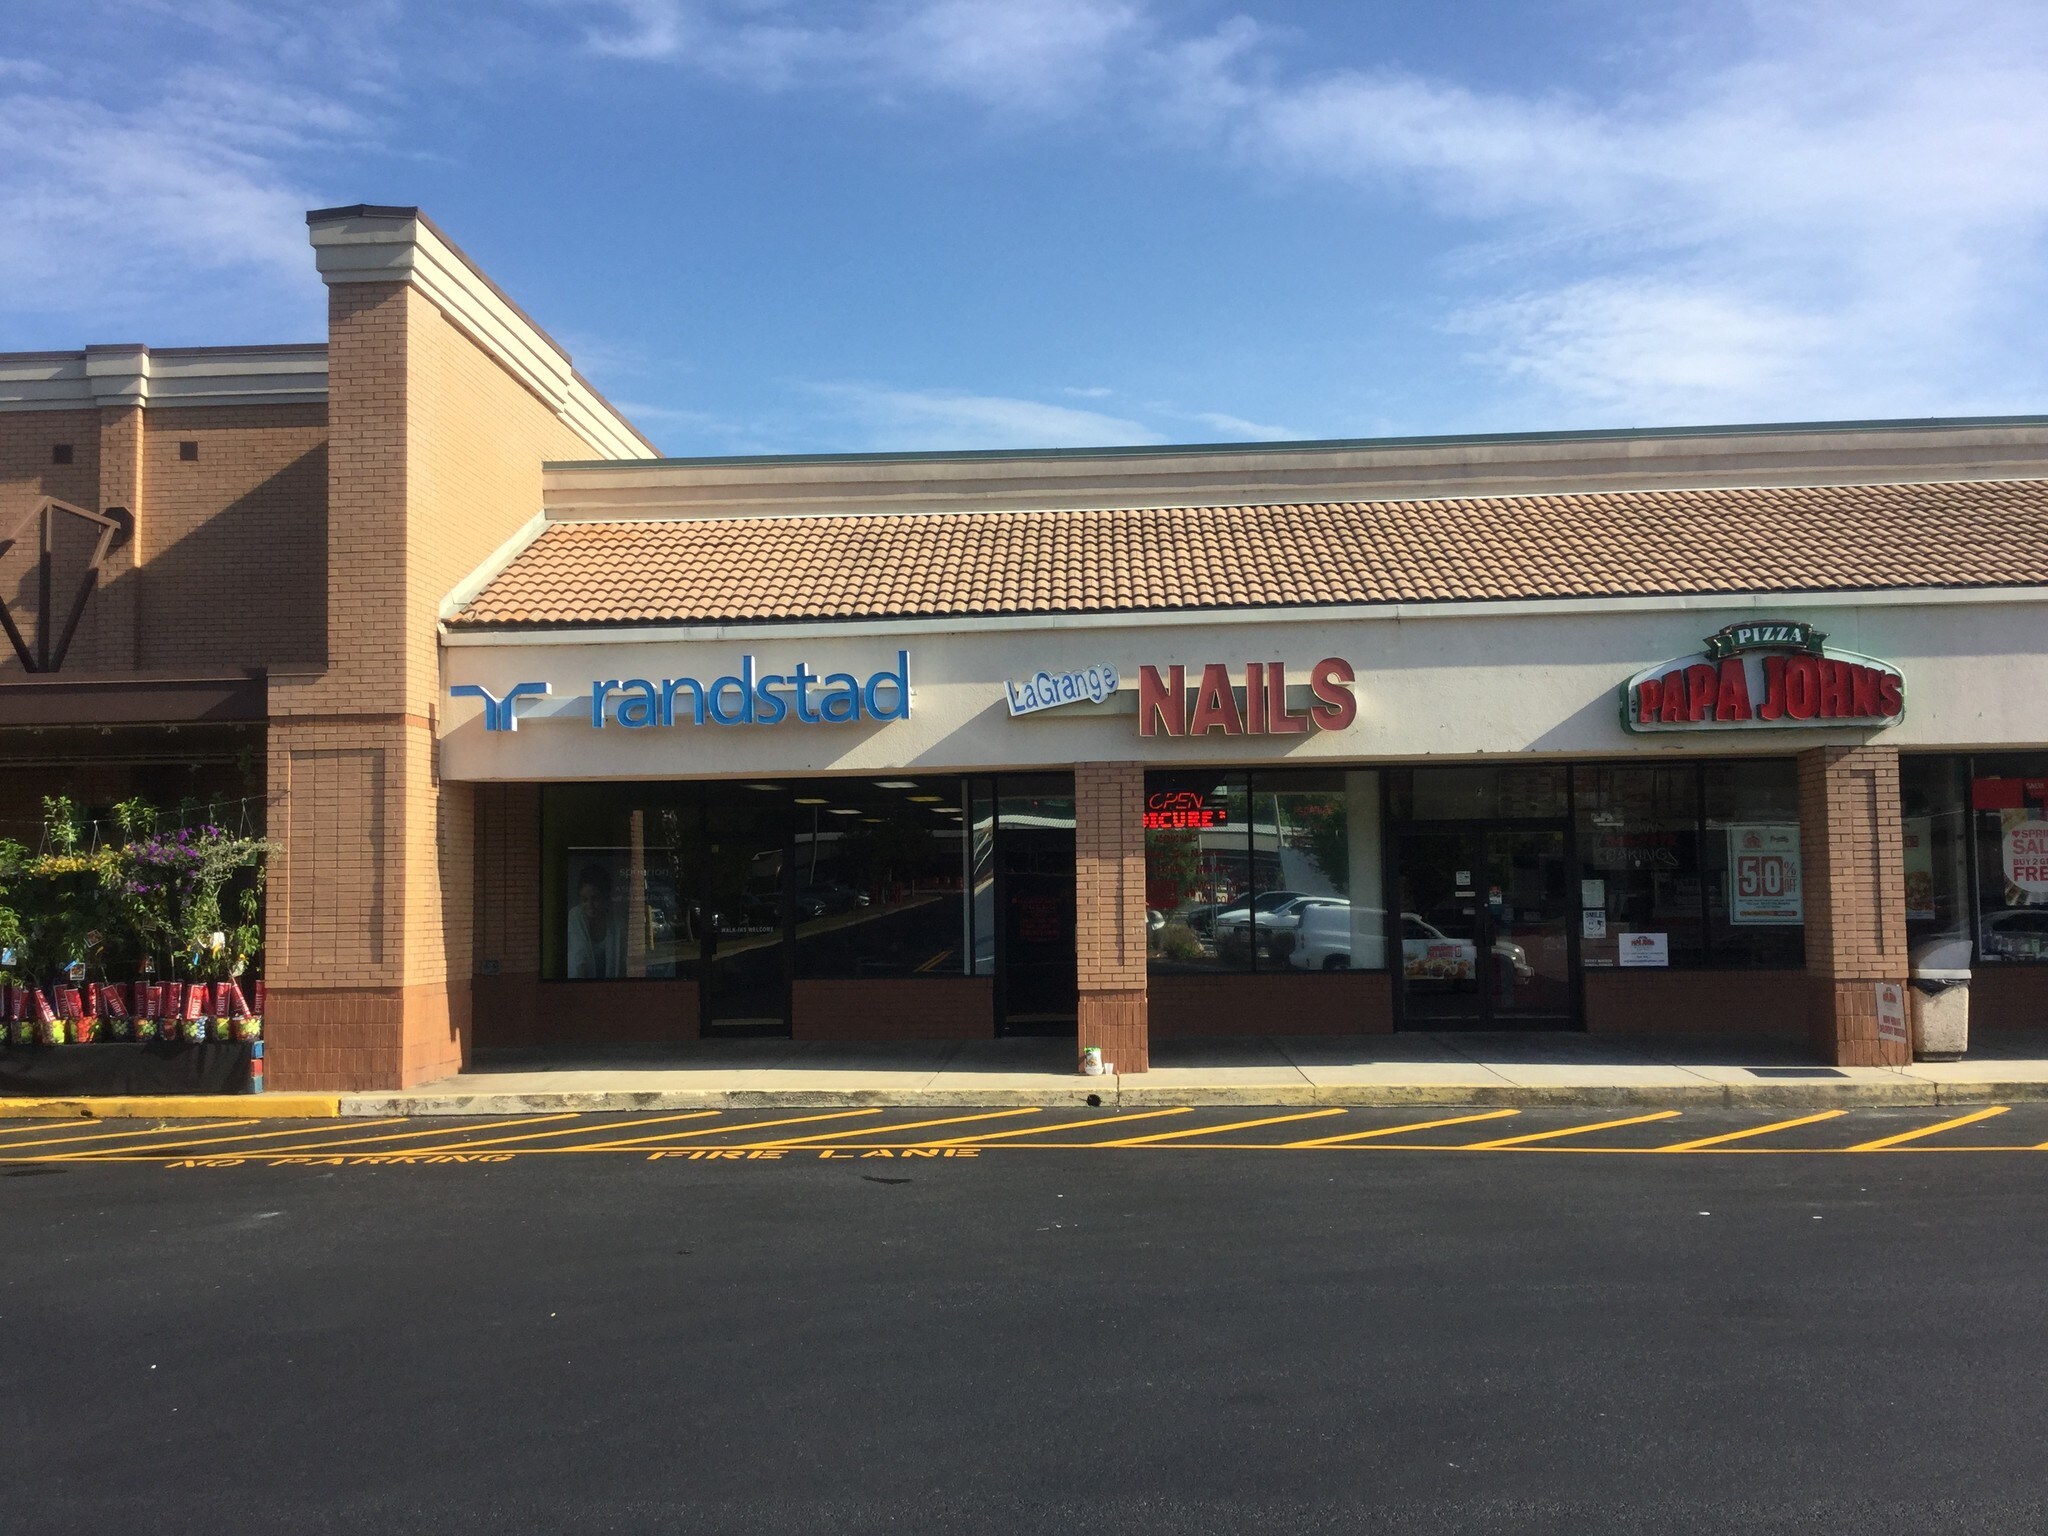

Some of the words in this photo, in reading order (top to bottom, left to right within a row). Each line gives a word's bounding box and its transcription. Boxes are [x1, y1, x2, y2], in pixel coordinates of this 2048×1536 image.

[1737, 626, 1803, 645] PIZZA
[592, 650, 911, 730] randstad
[1007, 663, 1117, 713] LaGrange
[1138, 656, 1358, 738] NAILS
[1637, 658, 1752, 723] PAPA
[1757, 655, 1904, 721] JOHN'S
[1149, 791, 1204, 810] OPEN
[2013, 858, 2031, 866] BUY
[2032, 858, 2038, 866] 2
[1784, 878, 1797, 893] OFF
[191, 998, 203, 1019] FRUIT
[216, 995, 227, 1016] FRUIT
[164, 1159, 246, 1169] NO
[267, 1154, 516, 1167] PARKING
[646, 1150, 789, 1160] FIRE
[818, 1148, 982, 1159] LANE
